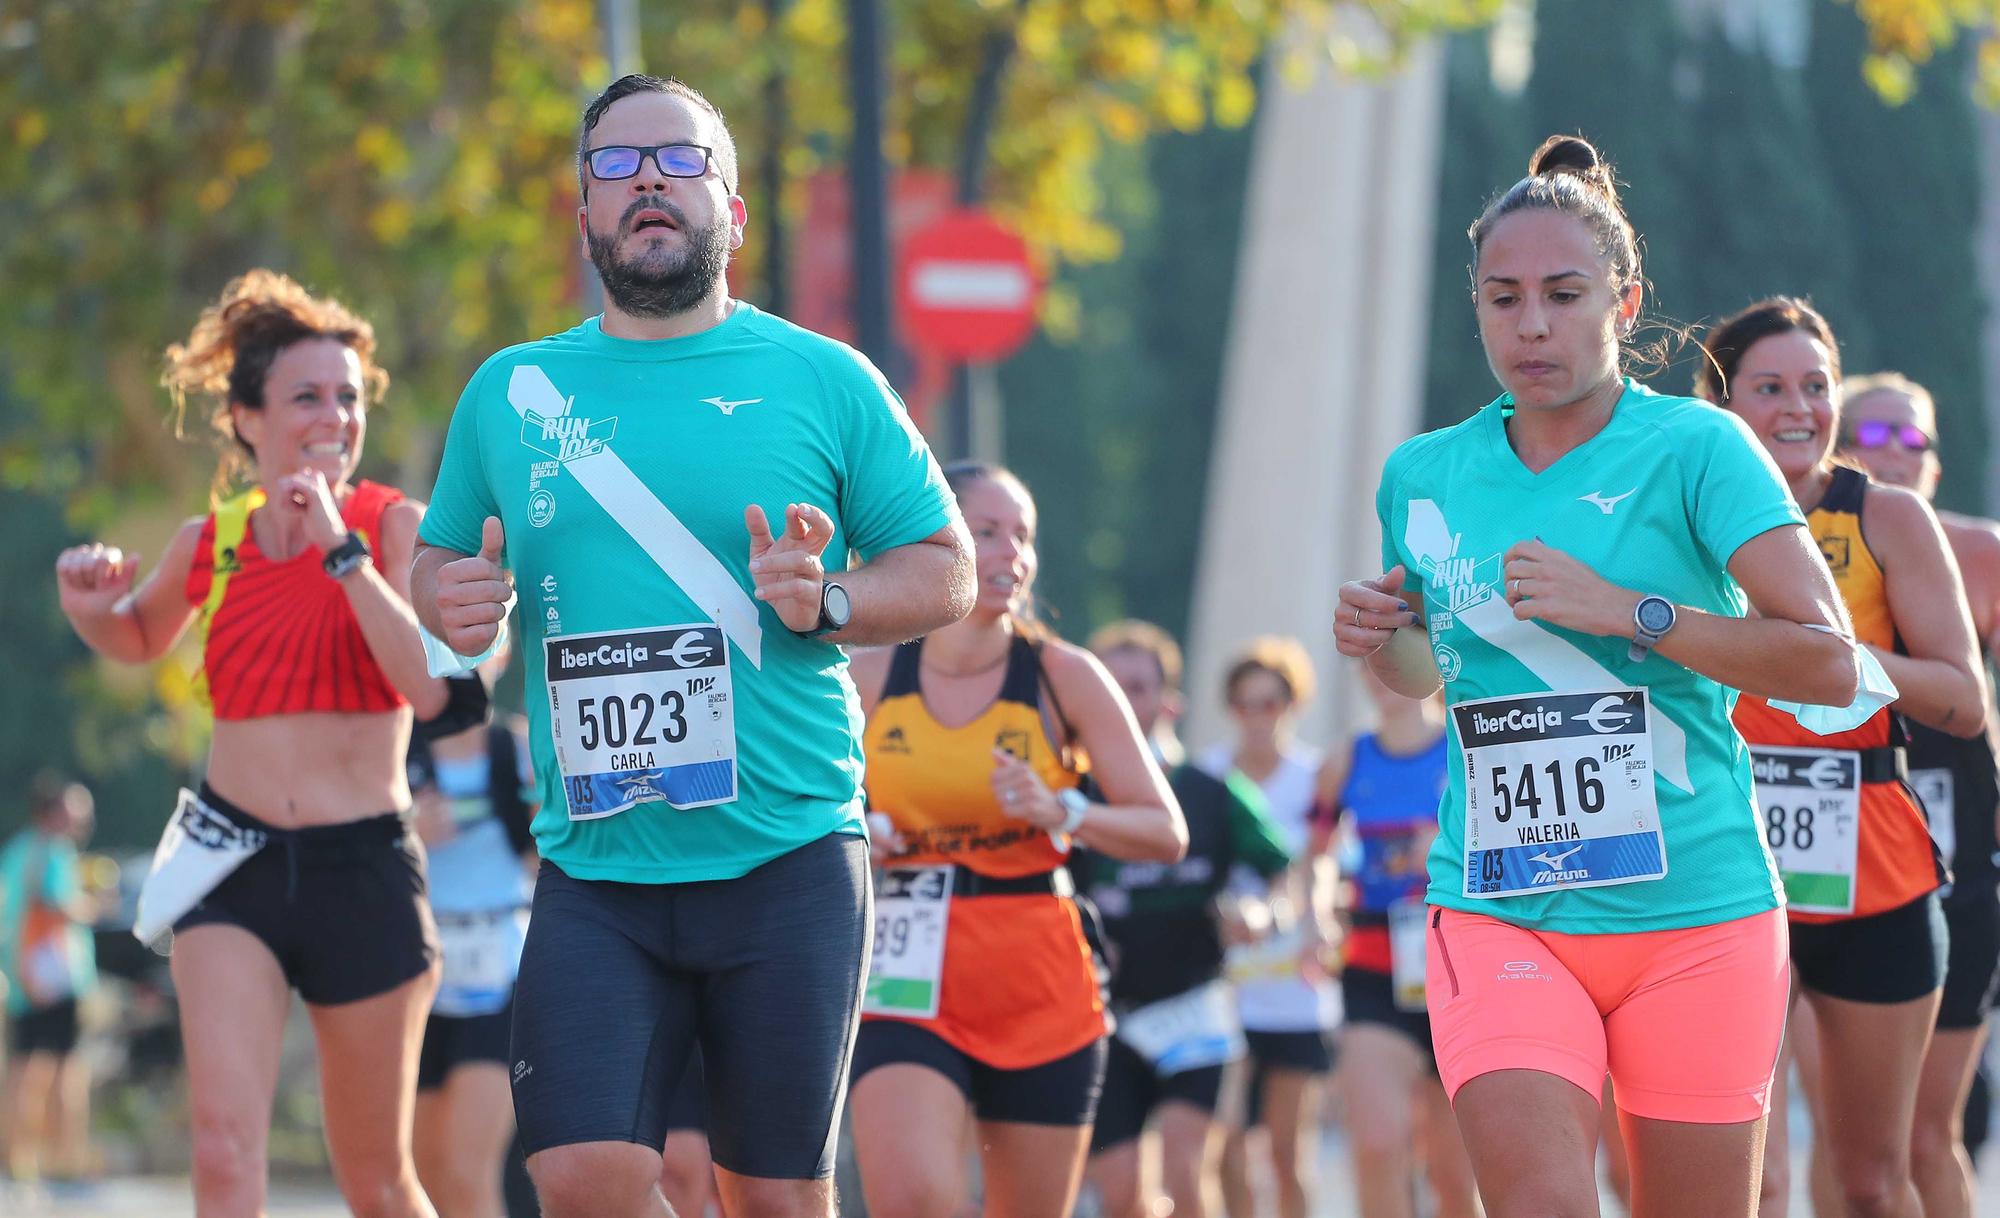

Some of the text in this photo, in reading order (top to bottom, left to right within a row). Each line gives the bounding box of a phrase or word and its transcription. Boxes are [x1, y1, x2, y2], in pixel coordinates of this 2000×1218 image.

[541, 417, 591, 441] RUN
[558, 438, 601, 461] 10K
[530, 461, 560, 472] VALENCIA
[1432, 557, 1475, 589] RUN
[1447, 582, 1488, 612] 10K
[561, 641, 649, 669] iberCaja
[686, 676, 716, 696] 10K
[578, 690, 688, 751] 5023
[1472, 705, 1563, 734] iberCaja
[611, 751, 656, 771] CARLA
[1602, 743, 1636, 763] 10K
[573, 775, 594, 805] 03
[1491, 756, 1605, 823] 5416
[1517, 821, 1581, 845] VALERIA
[1468, 851, 1478, 894] SALIDA
[1482, 849, 1504, 882] 03
